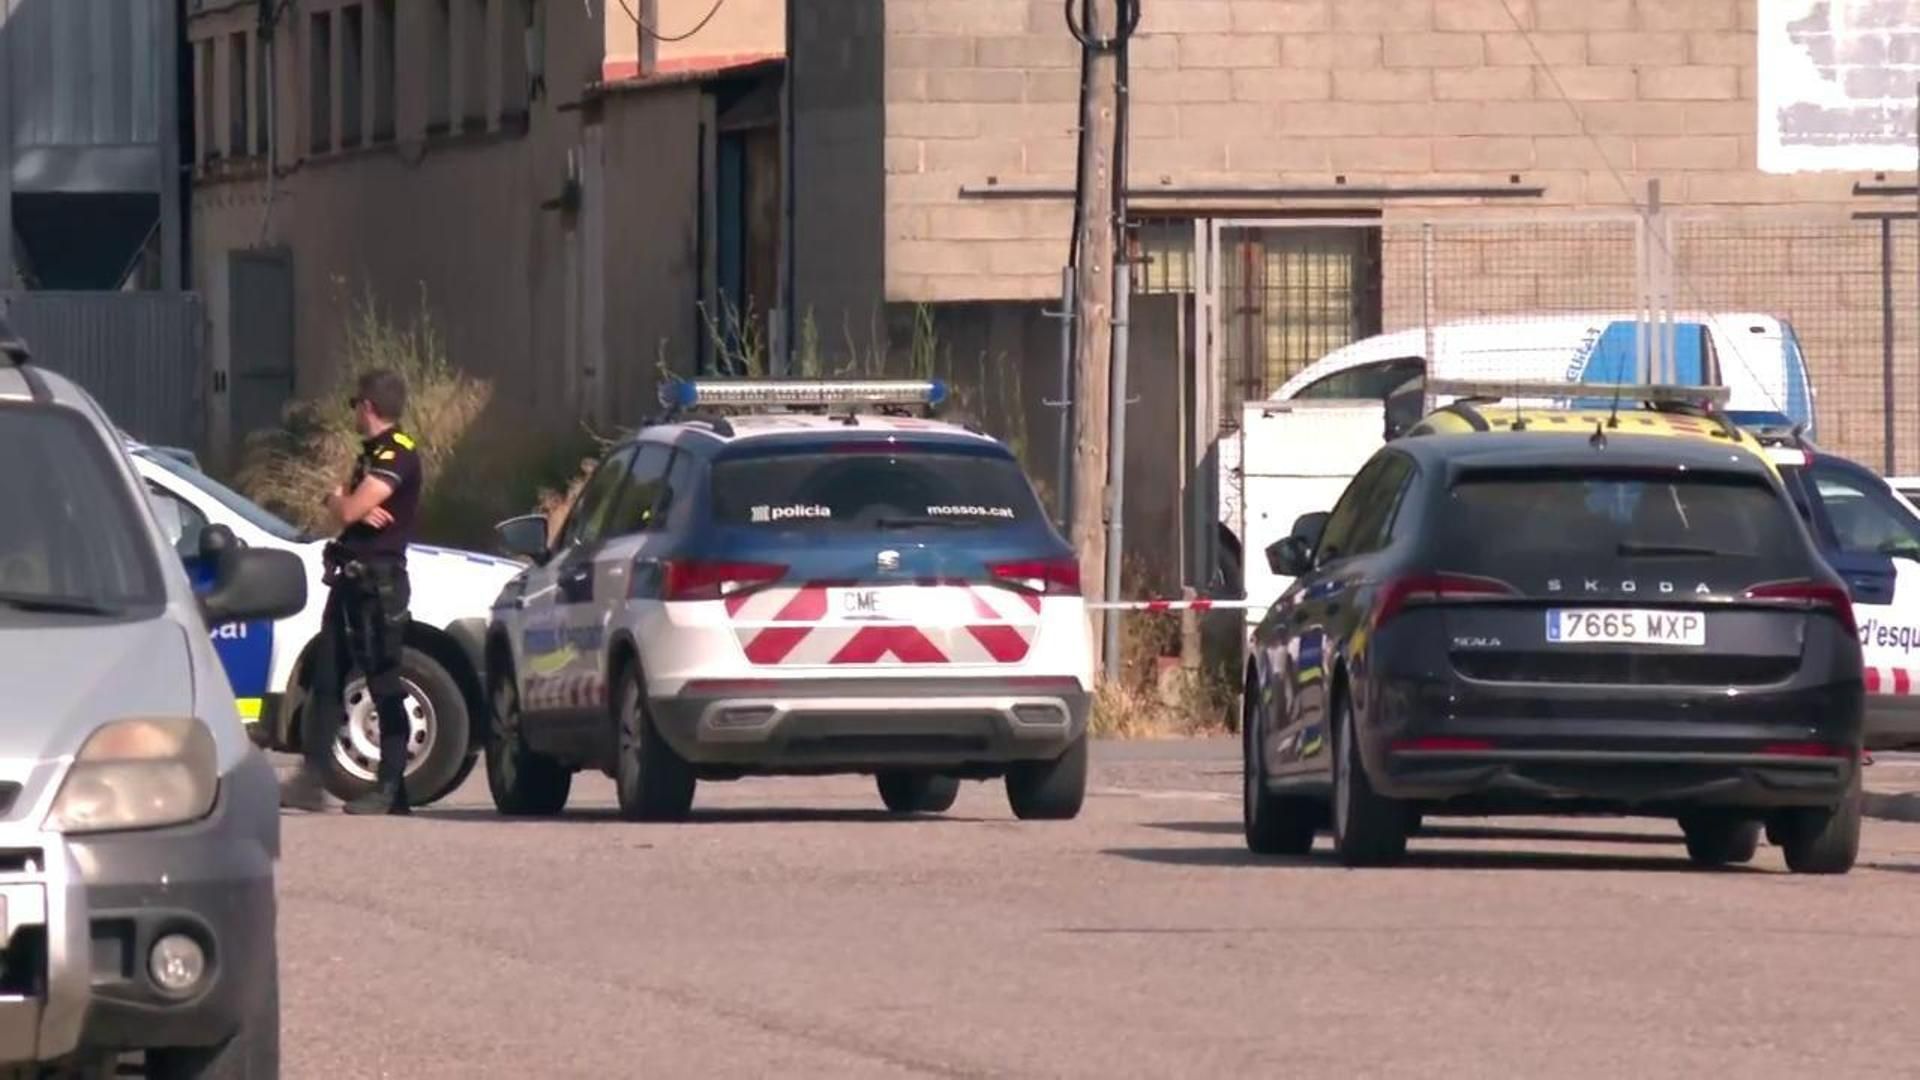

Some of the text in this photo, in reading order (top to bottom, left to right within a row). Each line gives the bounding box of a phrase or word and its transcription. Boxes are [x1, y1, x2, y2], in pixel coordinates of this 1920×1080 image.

[771, 504, 832, 520] policia
[926, 505, 1016, 519] mossos.cat
[1566, 612, 1698, 640] 7665 MXP
